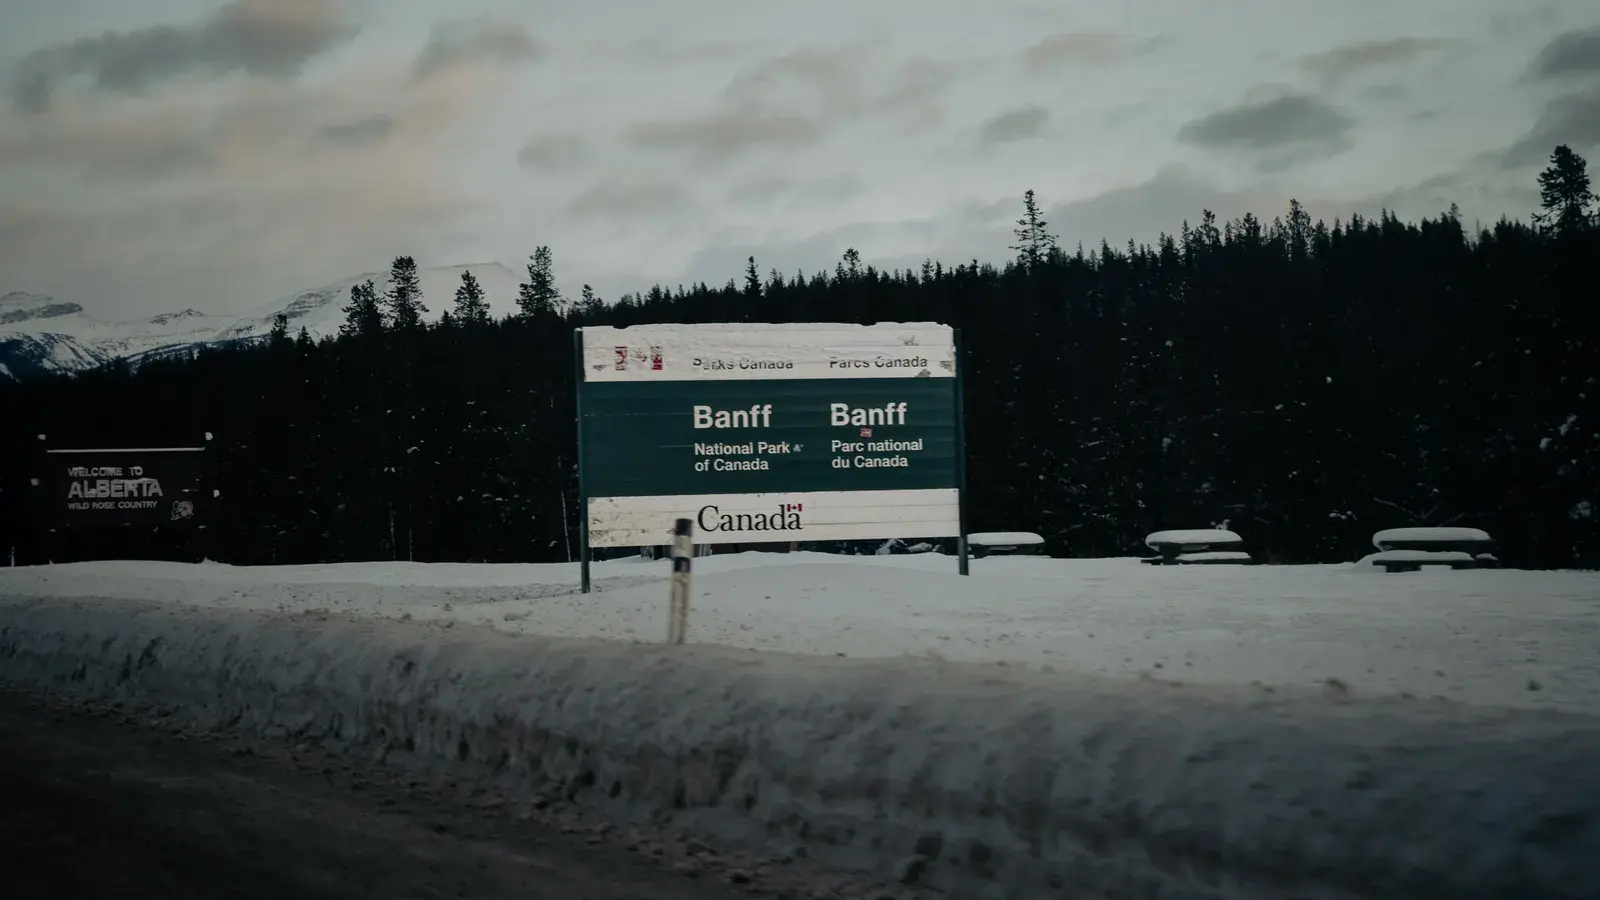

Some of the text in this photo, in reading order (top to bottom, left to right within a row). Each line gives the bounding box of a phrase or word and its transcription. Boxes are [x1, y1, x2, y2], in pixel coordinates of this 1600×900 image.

[829, 356, 928, 369] Parcs Canada
[693, 404, 773, 429] Banff
[829, 402, 908, 426] Banff
[694, 441, 791, 455] National Park
[831, 439, 923, 452] Parc national
[694, 458, 769, 471] of Canada
[831, 455, 909, 468] du Canada
[68, 465, 144, 477] WELCOME TO
[68, 478, 164, 499] ALBERTA
[68, 500, 158, 510] WILD ROSE COUNTRY
[698, 503, 803, 532] Canada
